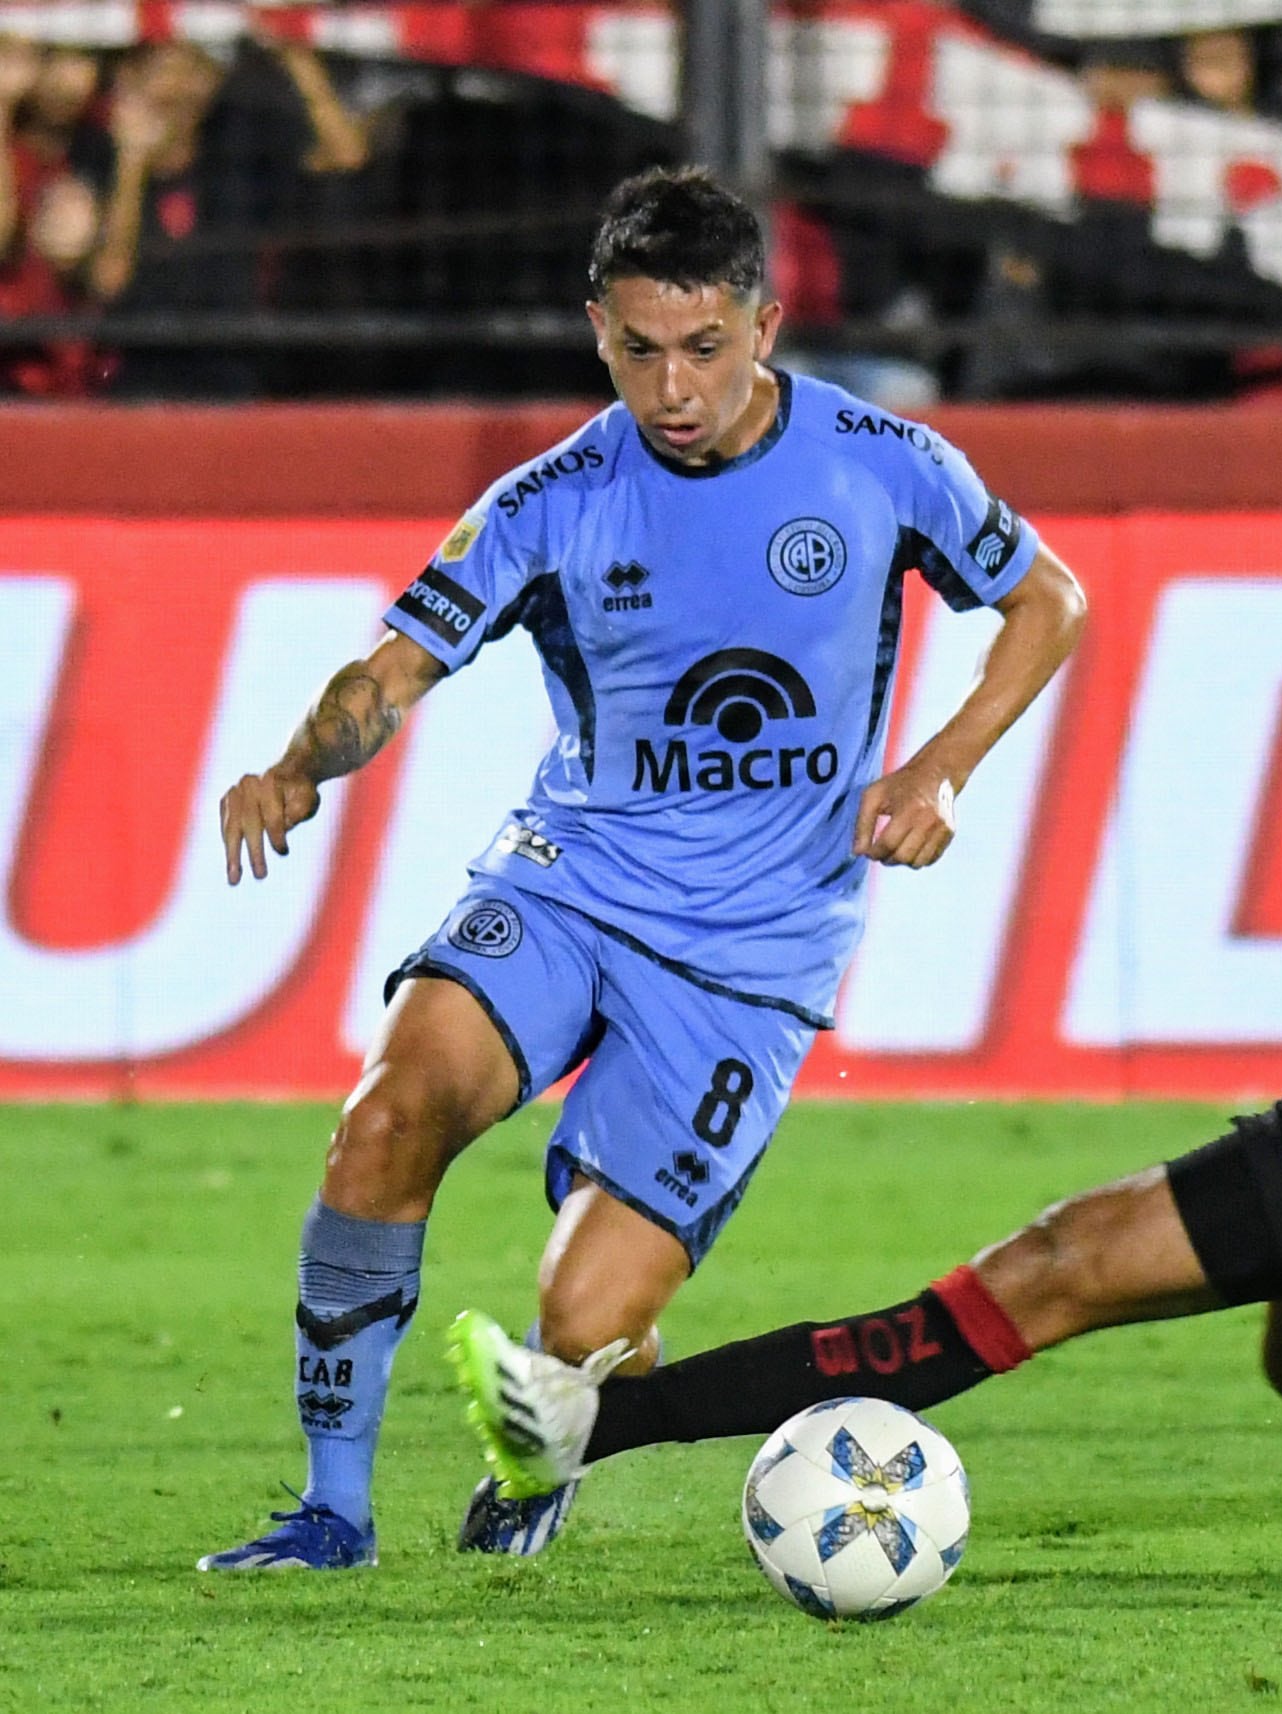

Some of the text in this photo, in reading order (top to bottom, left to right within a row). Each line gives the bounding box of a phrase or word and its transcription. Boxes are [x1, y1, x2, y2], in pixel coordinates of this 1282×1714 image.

[497, 445, 604, 518] SANOS
[631, 738, 838, 793] Macro
[692, 1058, 754, 1149] 8
[299, 1356, 353, 1388] CAB
